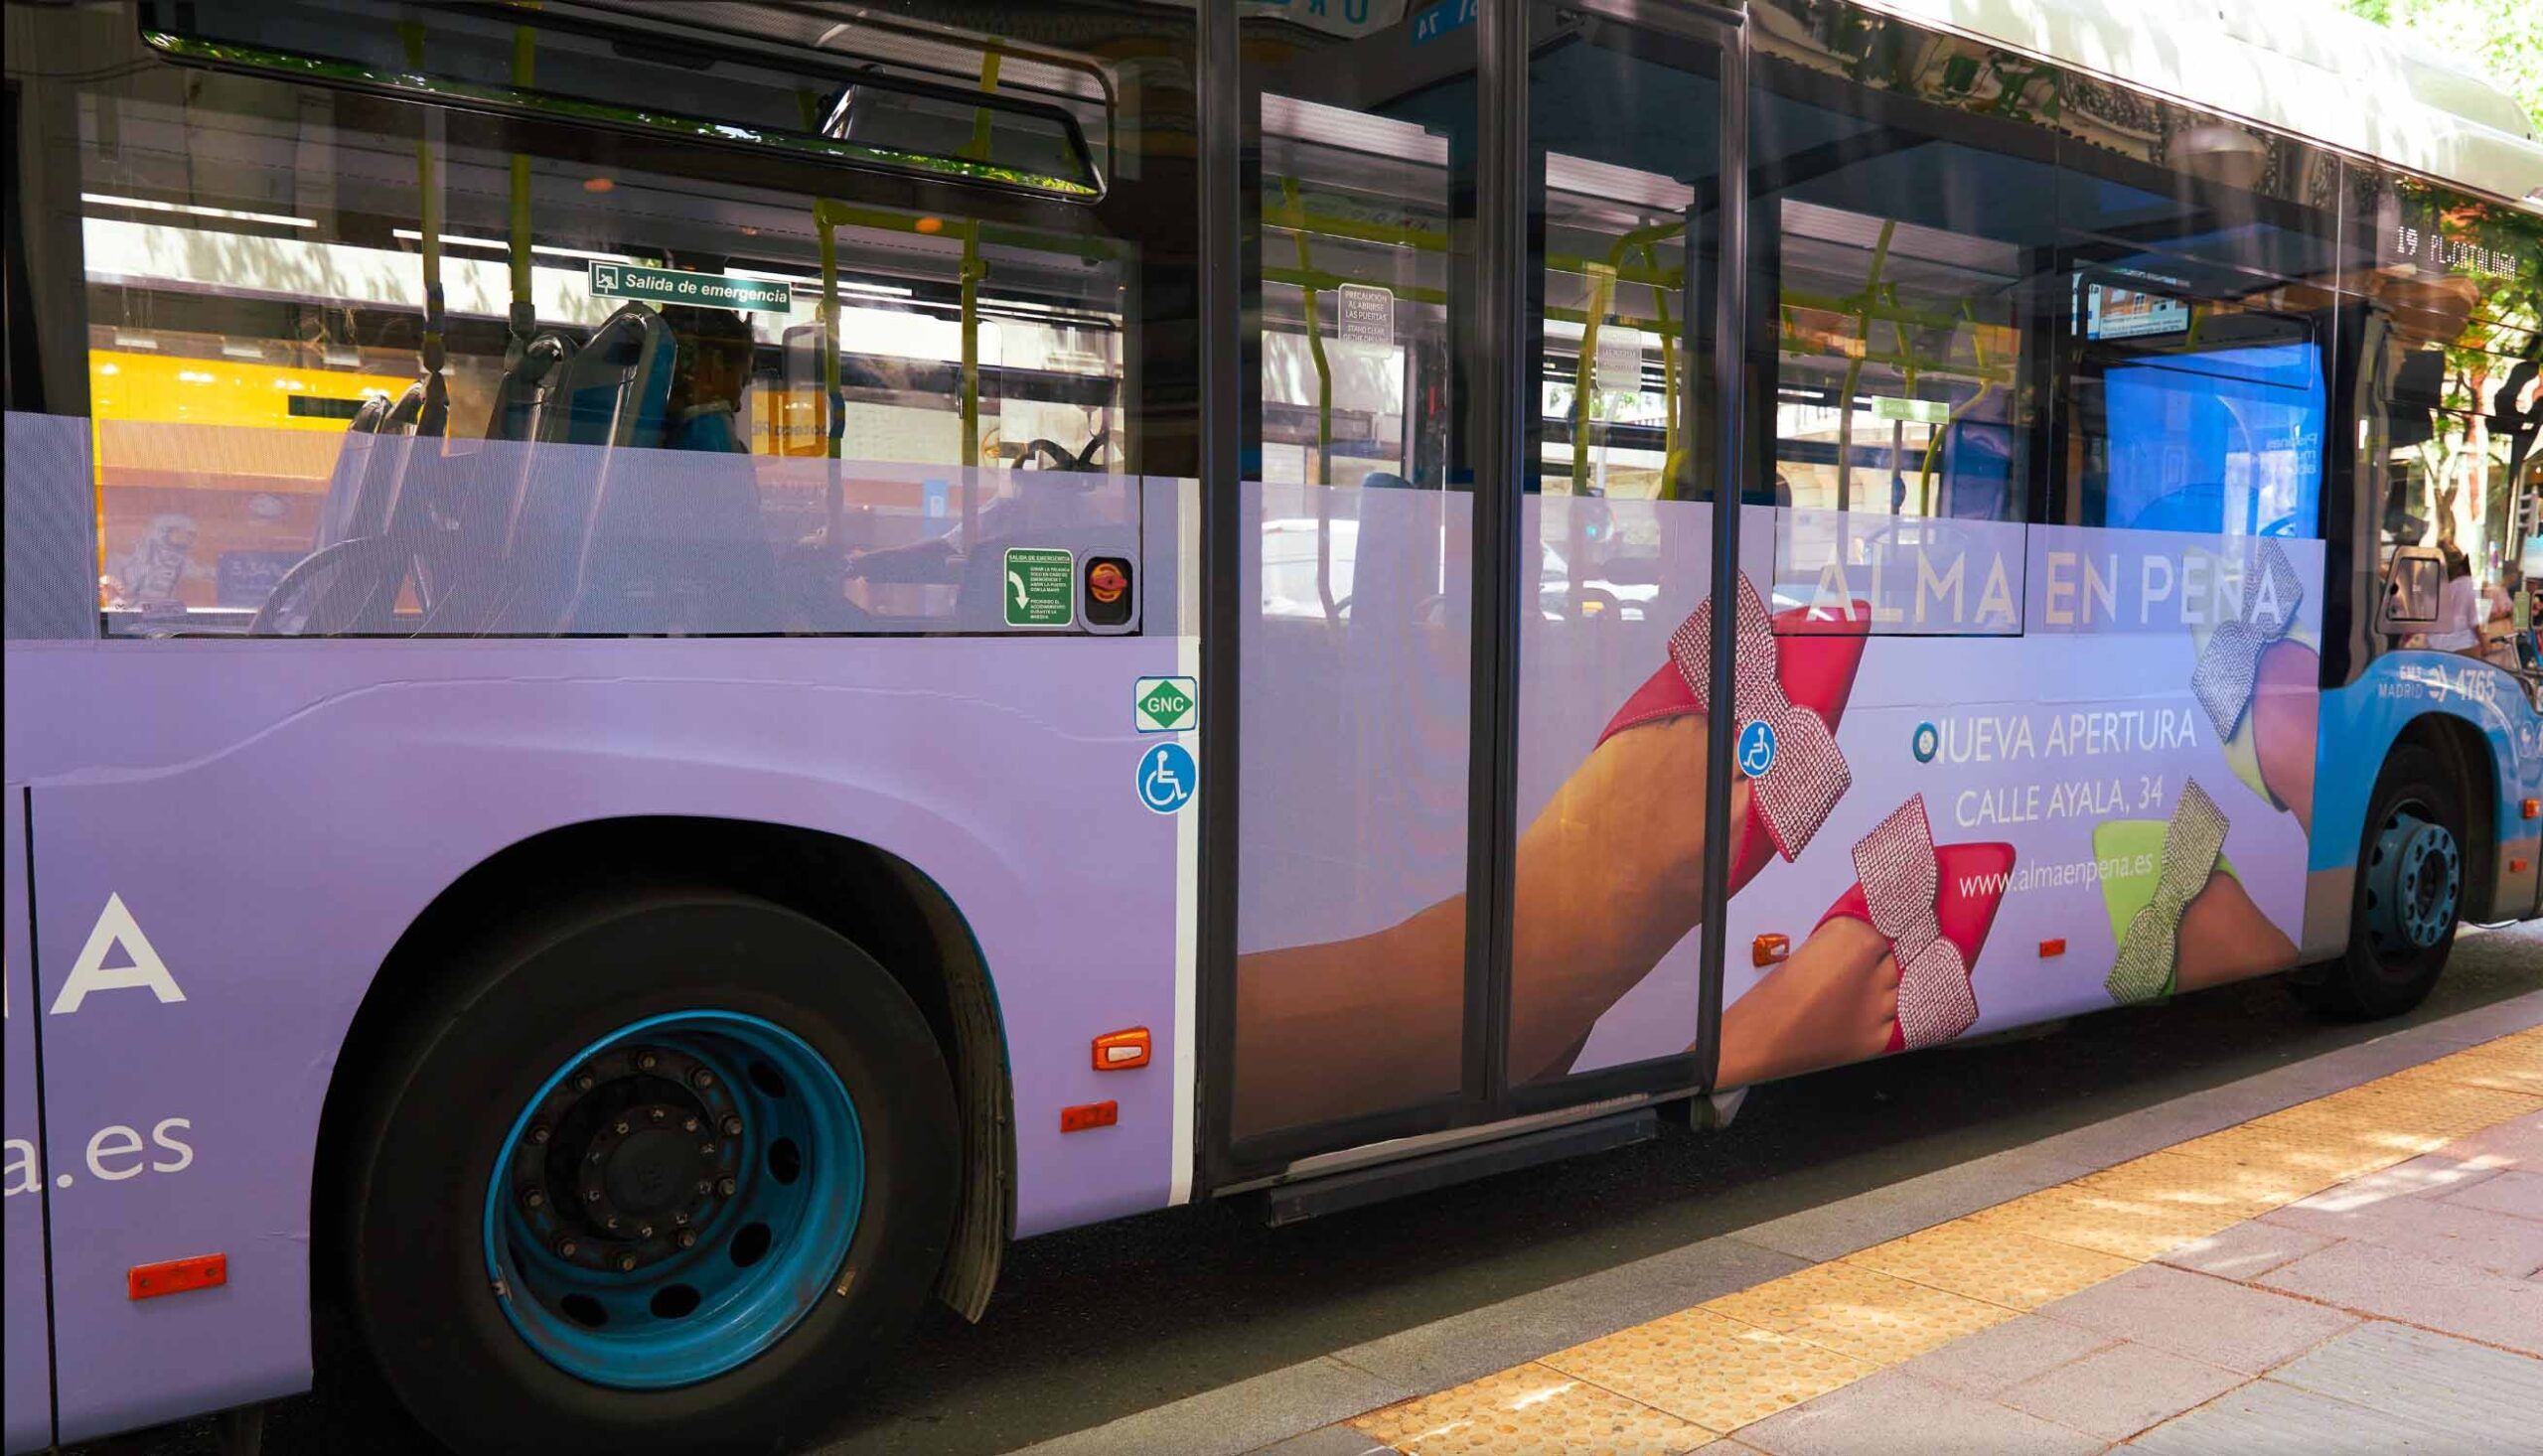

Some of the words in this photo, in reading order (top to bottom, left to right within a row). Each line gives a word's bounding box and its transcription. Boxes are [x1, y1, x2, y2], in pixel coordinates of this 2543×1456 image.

[2398, 226, 2418, 255] 19
[625, 274, 673, 291] Salida
[677, 278, 696, 294] de
[701, 284, 788, 303] emergencia
[1345, 310, 1358, 319] LAS
[1358, 312, 1387, 321] PUERTAS
[1805, 543, 2018, 624] ALMA
[2044, 551, 2119, 626] EN
[2378, 682, 2424, 699] MADRID
[2455, 668, 2496, 703] 4765
[1147, 697, 1184, 713] GNC
[2044, 708, 2197, 758] APERTURA
[1955, 786, 2040, 827] CALLE
[2046, 779, 2130, 817] AYALA,
[2138, 775, 2164, 809] 34
[1959, 853, 2154, 899] www.almaenpena.es
